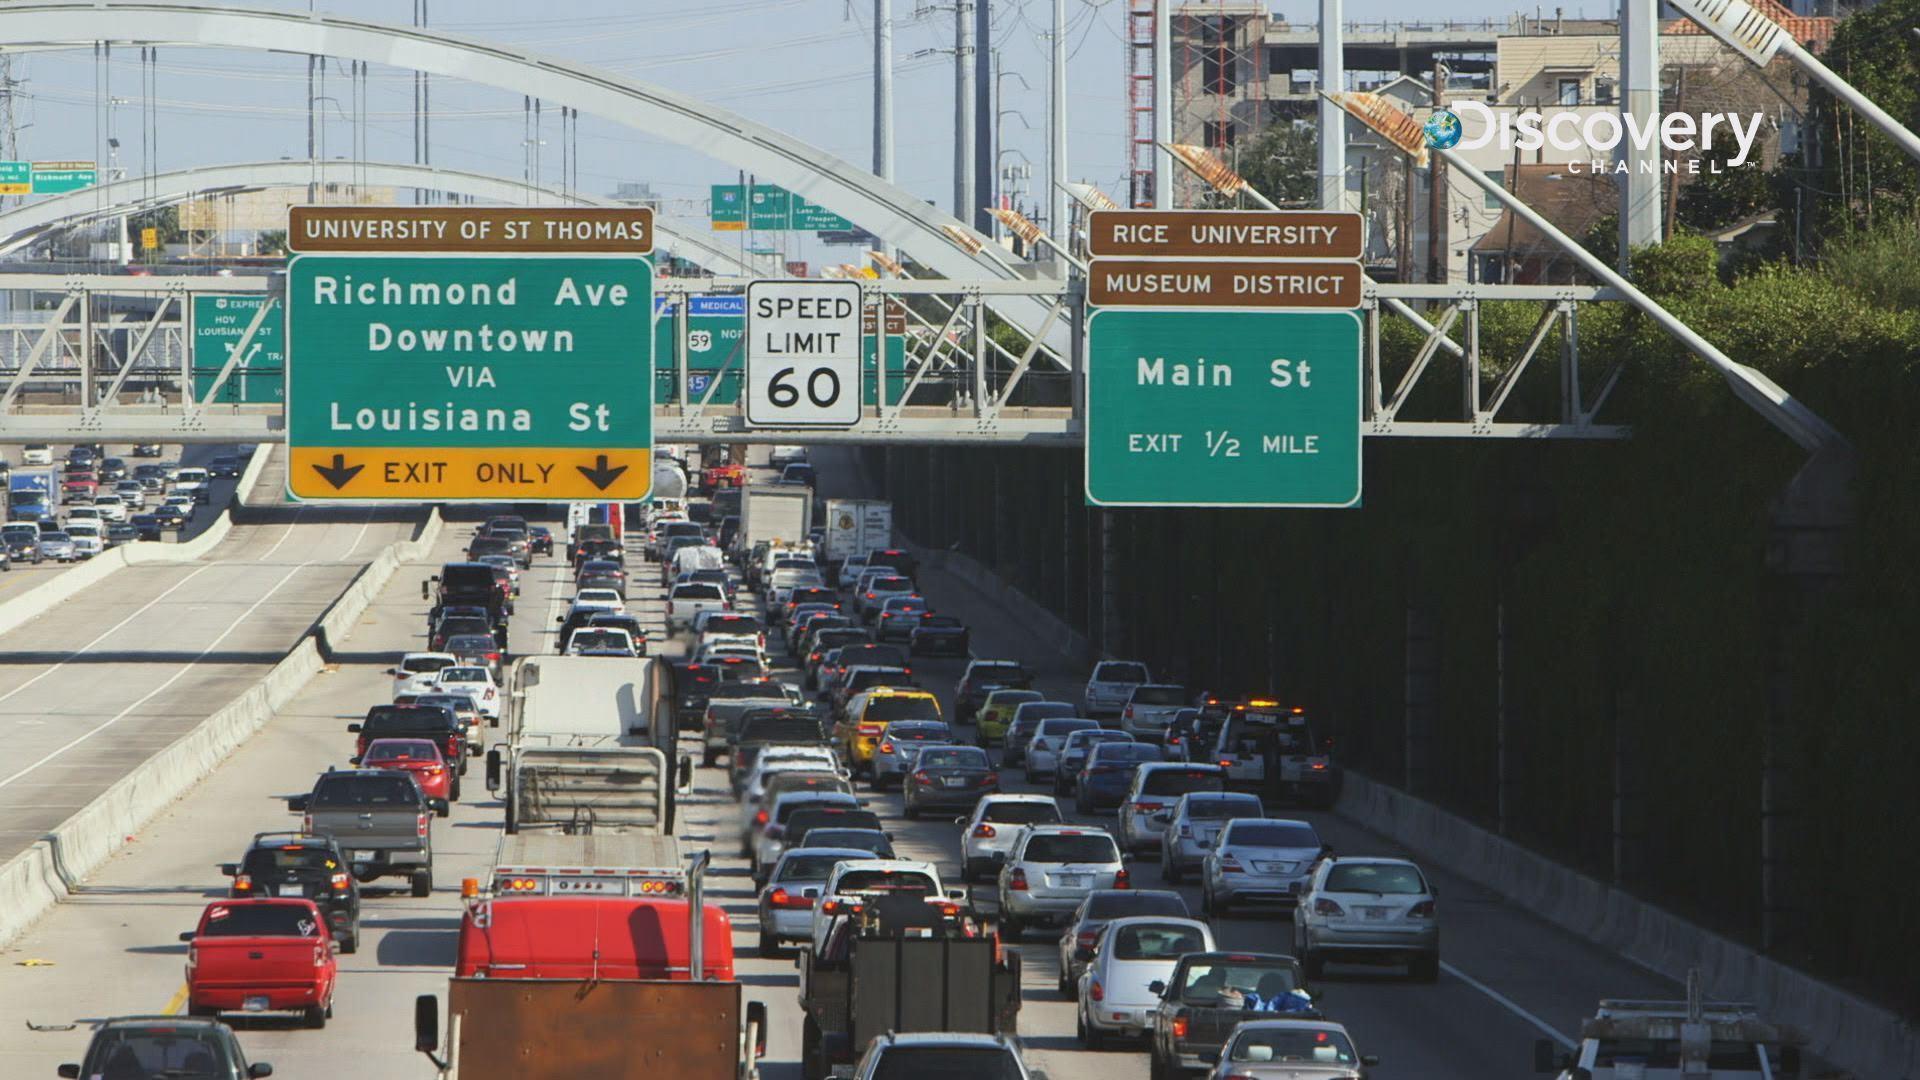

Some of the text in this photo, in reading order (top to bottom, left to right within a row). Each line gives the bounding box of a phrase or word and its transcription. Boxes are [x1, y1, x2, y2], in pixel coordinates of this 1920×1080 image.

[307, 220, 642, 239] UNIVERSITY OF ST THOMAS
[1114, 225, 1337, 244] RICE UNIVERSITY
[315, 276, 627, 305] Richmond Ave
[1107, 274, 1344, 294] MUSEUM DISTRICT
[230, 300, 271, 309] EXPRE
[700, 302, 743, 310] MEDICAL
[758, 298, 851, 318] SPEED
[215, 316, 236, 324] HOV
[198, 327, 272, 336] LOUISIAN ST
[370, 323, 572, 351] Downtown
[691, 335, 709, 347] 59
[768, 333, 840, 353] LIMIT
[447, 367, 496, 387] VIA
[1138, 358, 1310, 387] Main St
[768, 367, 840, 408] 60
[331, 402, 609, 431] Louisiana St
[1130, 434, 1182, 452] EXIT
[1264, 436, 1318, 453] MILE
[385, 462, 554, 483] EXIT ONLY
